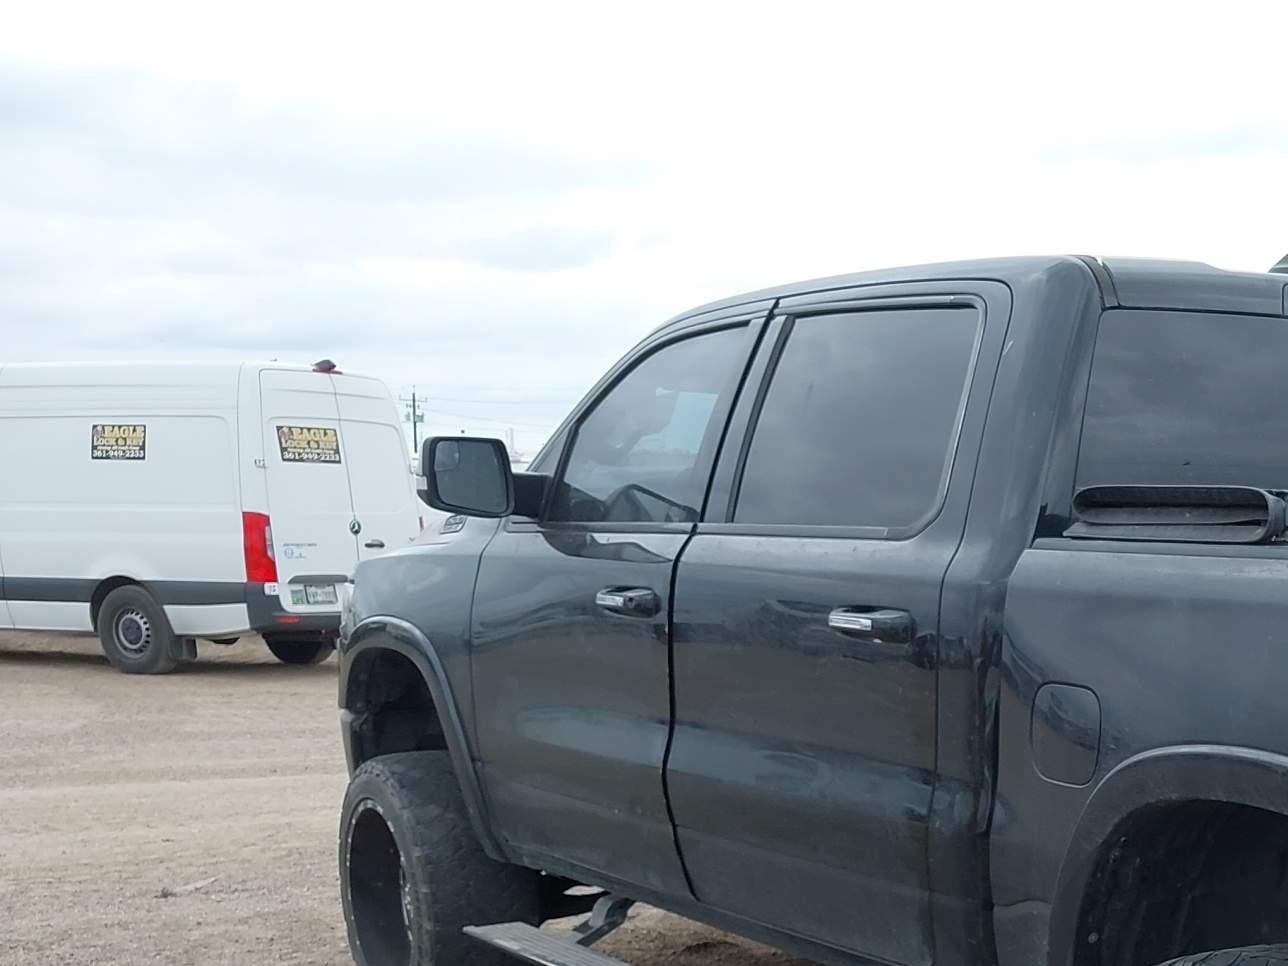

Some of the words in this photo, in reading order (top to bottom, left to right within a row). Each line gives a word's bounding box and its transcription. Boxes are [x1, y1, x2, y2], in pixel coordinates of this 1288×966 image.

[103, 426, 145, 437] EAGLE
[291, 427, 337, 441] EAGLE
[94, 436, 117, 446] LOCK
[126, 437, 145, 446] KEY
[282, 438, 309, 449] LOCK
[319, 441, 337, 450] KEY
